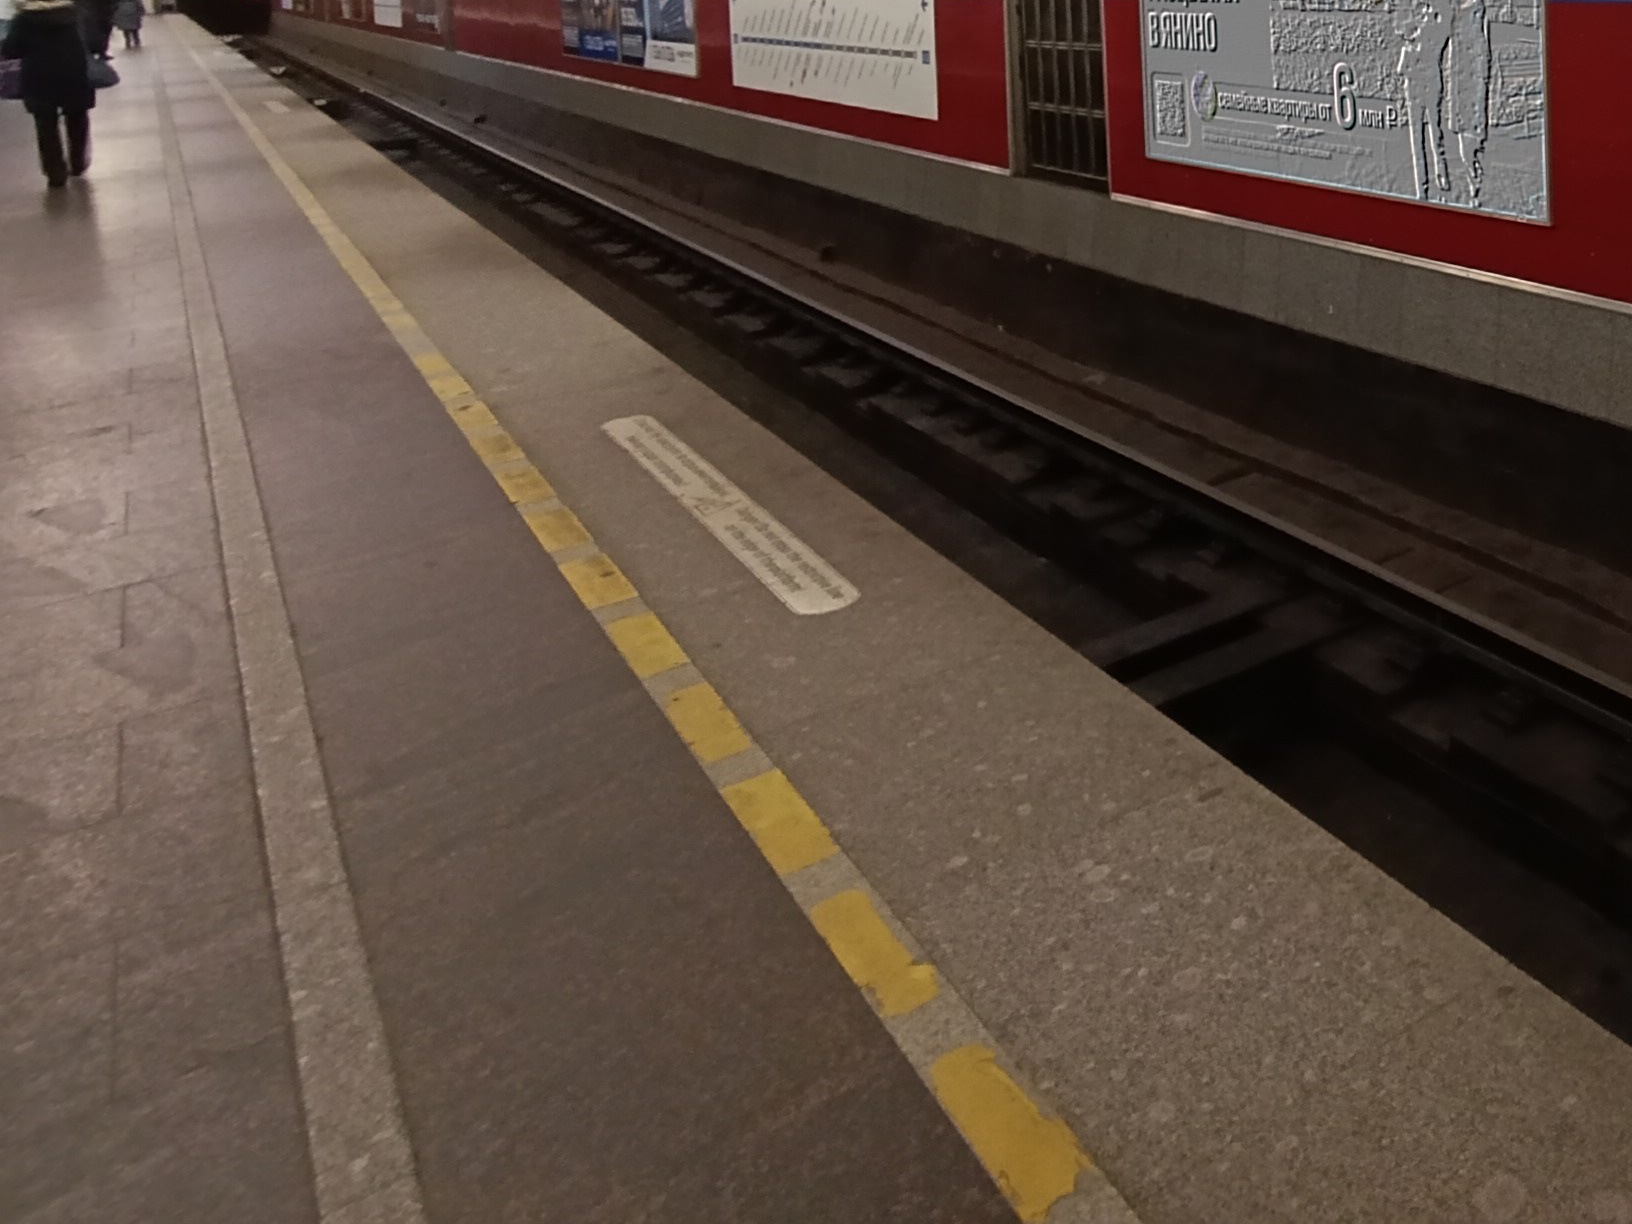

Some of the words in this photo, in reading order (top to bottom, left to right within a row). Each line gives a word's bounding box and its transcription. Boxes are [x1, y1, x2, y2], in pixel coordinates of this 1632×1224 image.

[1161, 12, 1218, 53] ЯНИНО
[1268, 97, 1318, 121] квартиры
[1333, 62, 1357, 130] 6
[1359, 108, 1384, 129] млн
